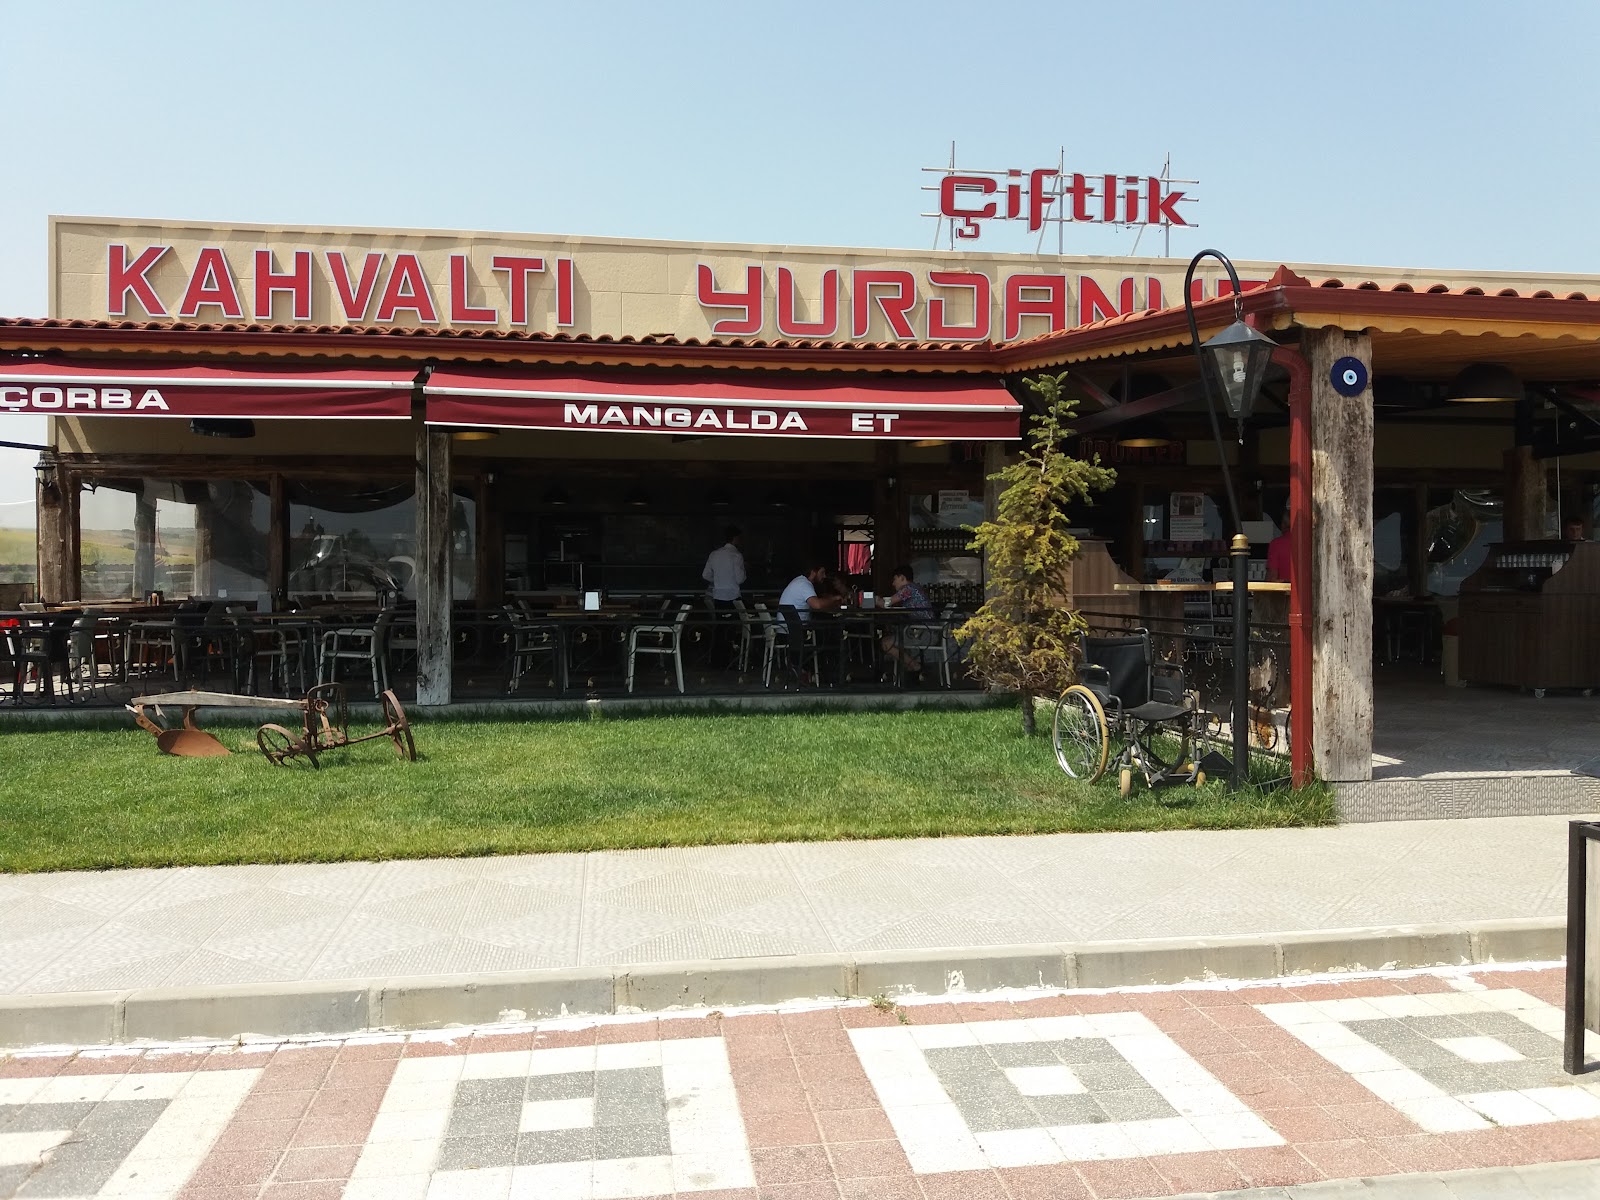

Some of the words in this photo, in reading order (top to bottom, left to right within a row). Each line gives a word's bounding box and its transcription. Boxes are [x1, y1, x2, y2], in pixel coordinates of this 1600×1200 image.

[940, 168, 1188, 239] Çiftlik
[107, 243, 575, 327] KAHVALTI
[0, 386, 170, 412] ÇORBA
[564, 403, 808, 431] MANGALDA
[851, 412, 900, 434] ET
